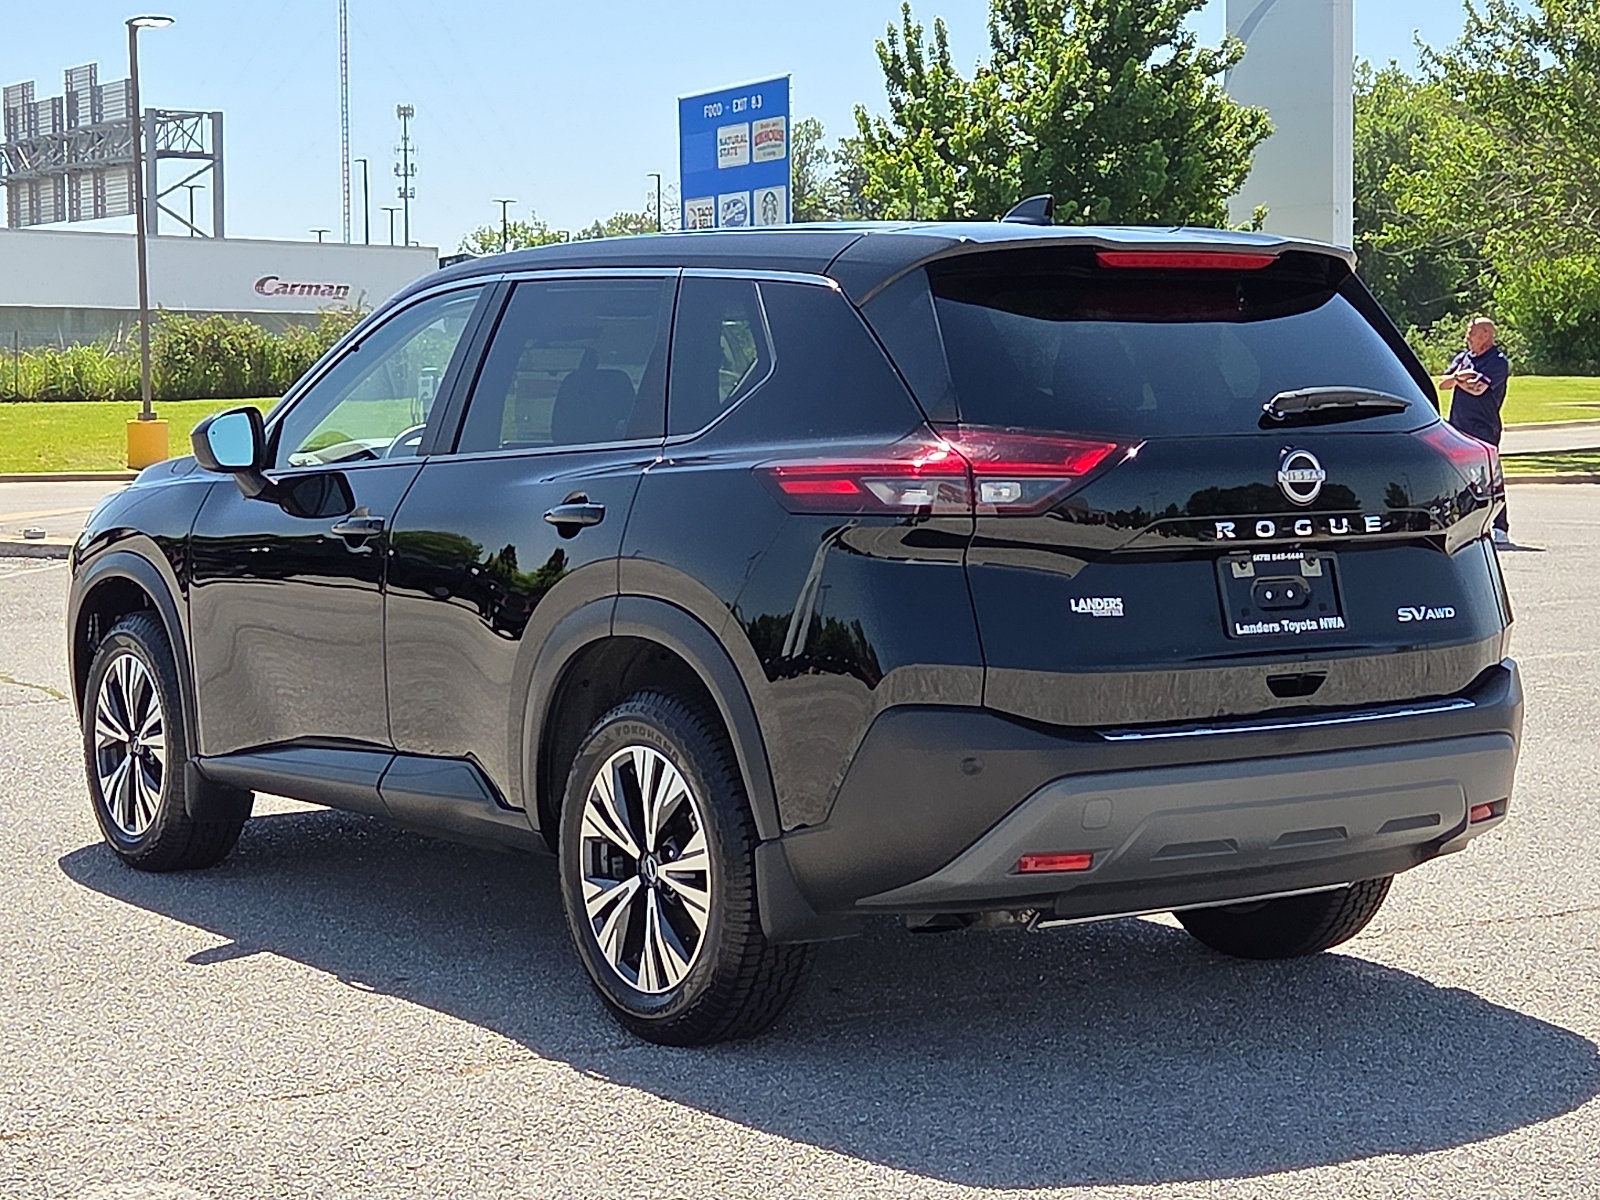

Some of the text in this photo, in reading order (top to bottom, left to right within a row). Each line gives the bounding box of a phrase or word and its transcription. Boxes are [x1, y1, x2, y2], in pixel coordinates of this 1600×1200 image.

[704, 102, 723, 118] FOOD
[732, 97, 748, 113] EXIT
[719, 145, 738, 158] STATE
[697, 206, 713, 217] TACO
[254, 275, 350, 297] Carman
[1278, 468, 1326, 482] NISSAN
[1214, 515, 1383, 540] ROGUE
[1070, 597, 1123, 613] LANDERS
[1397, 606, 1456, 622] SV AWD
[1235, 616, 1345, 635] Landers Toyota NWA
